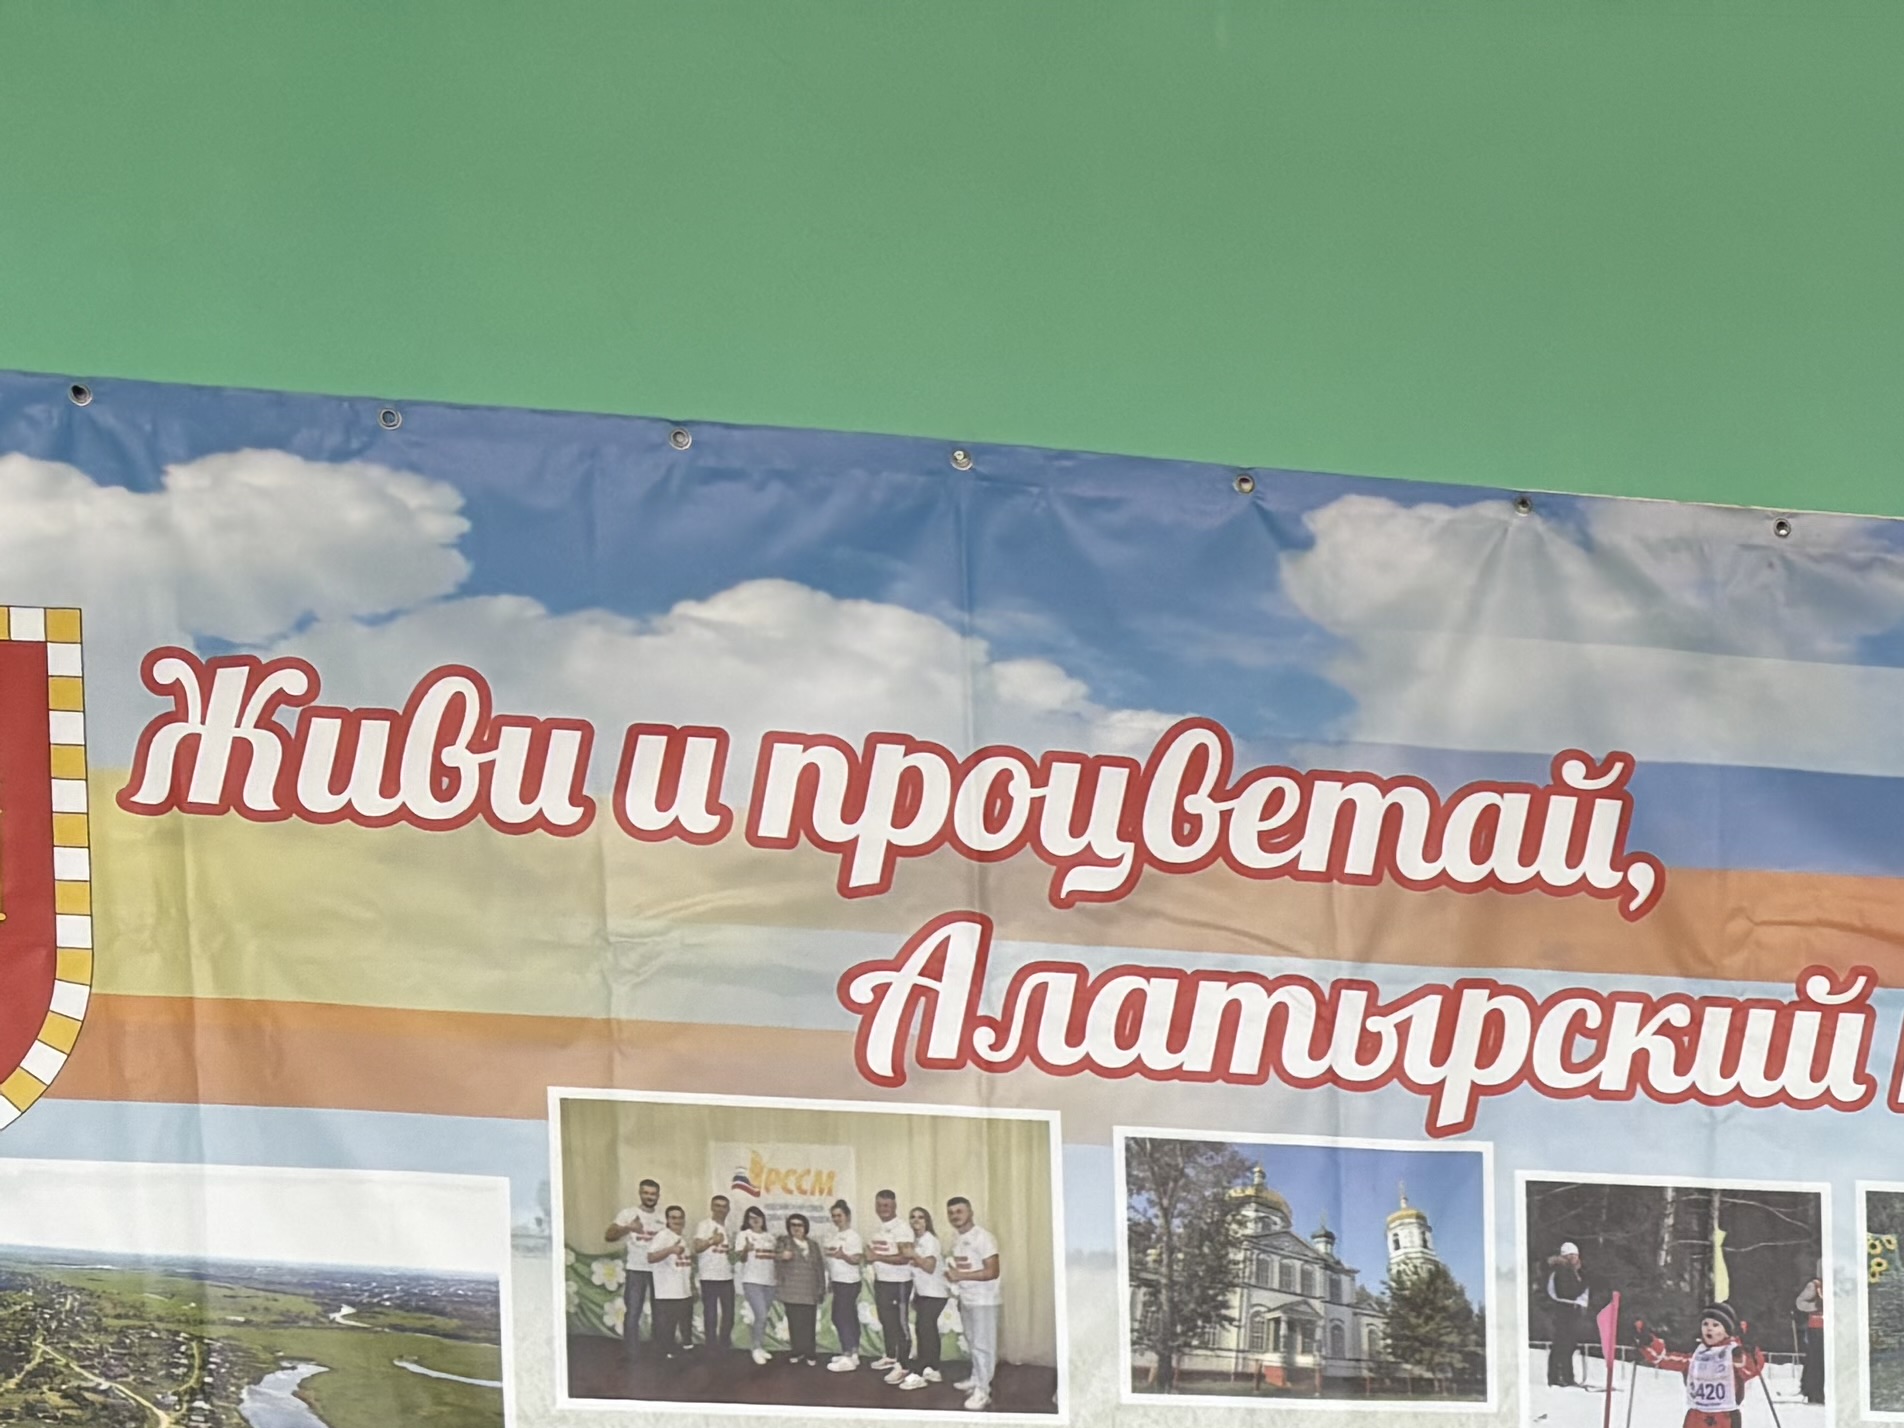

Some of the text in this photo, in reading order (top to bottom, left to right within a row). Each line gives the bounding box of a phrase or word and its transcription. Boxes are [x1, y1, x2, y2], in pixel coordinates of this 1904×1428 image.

[118, 648, 1662, 921] Живи и процветай,
[839, 912, 1875, 1135] Алатырский
